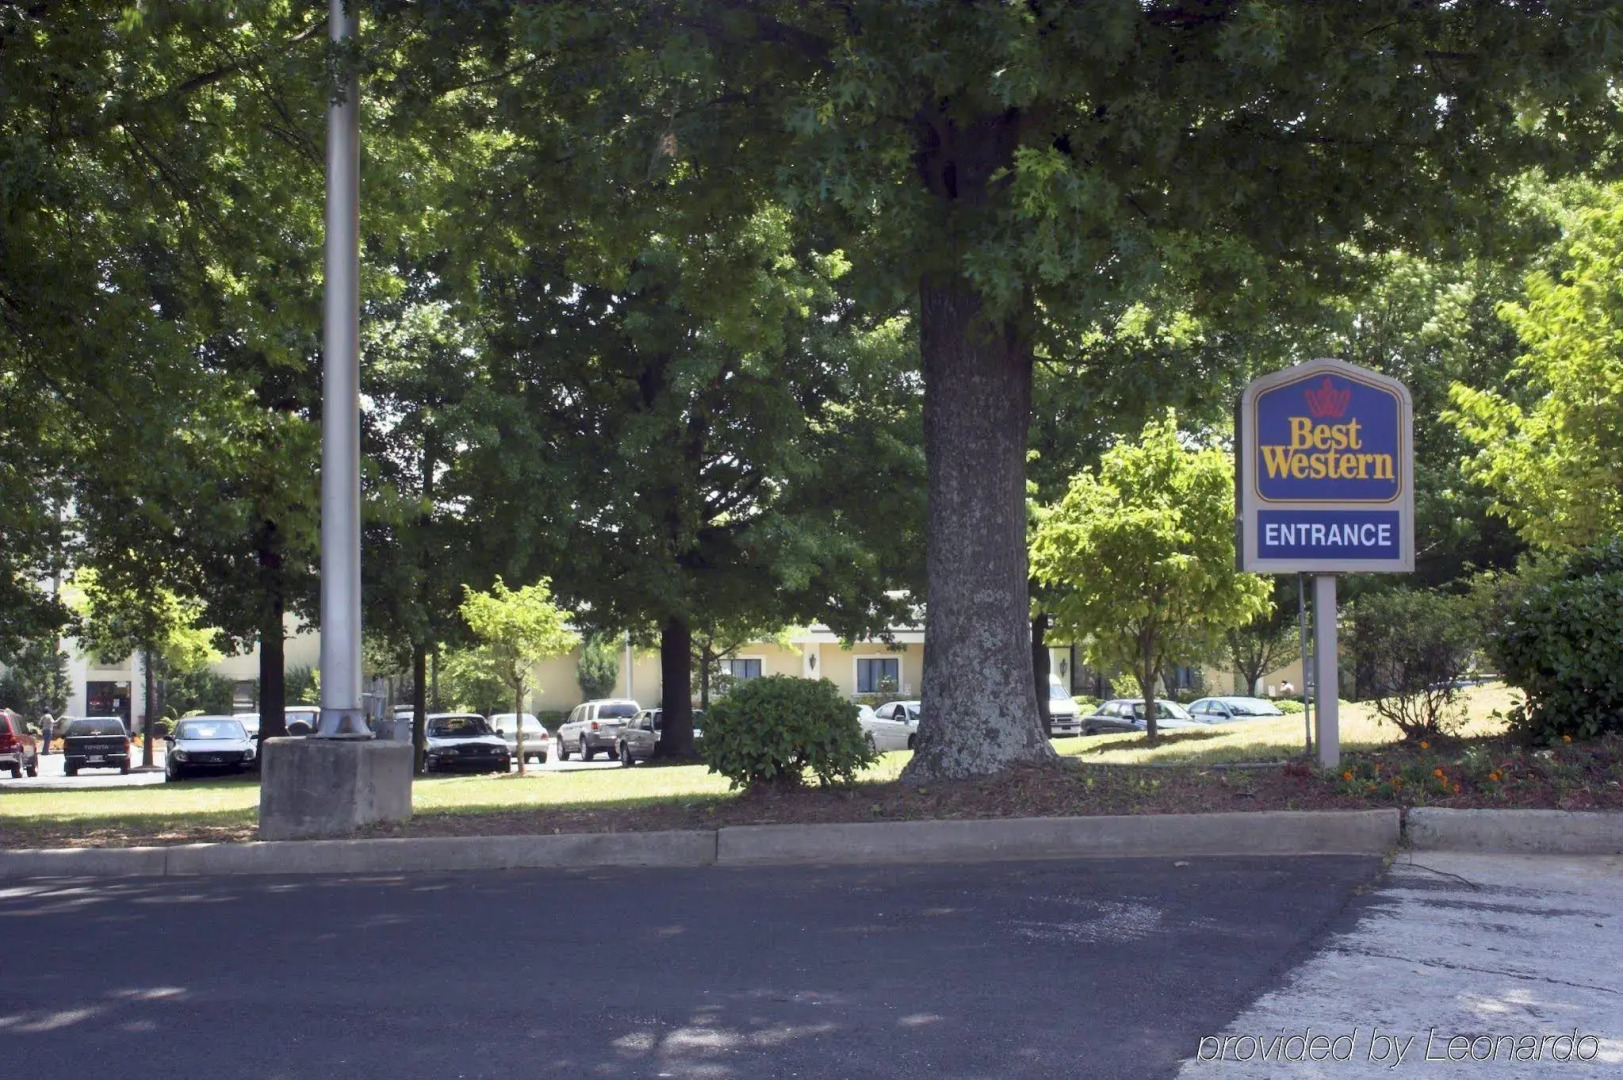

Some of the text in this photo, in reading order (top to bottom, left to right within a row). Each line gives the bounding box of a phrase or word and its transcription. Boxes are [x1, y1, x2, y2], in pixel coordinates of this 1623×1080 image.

[1288, 417, 1362, 449] Best
[1261, 445, 1394, 479] Western
[1265, 523, 1392, 546] ENTRANCE
